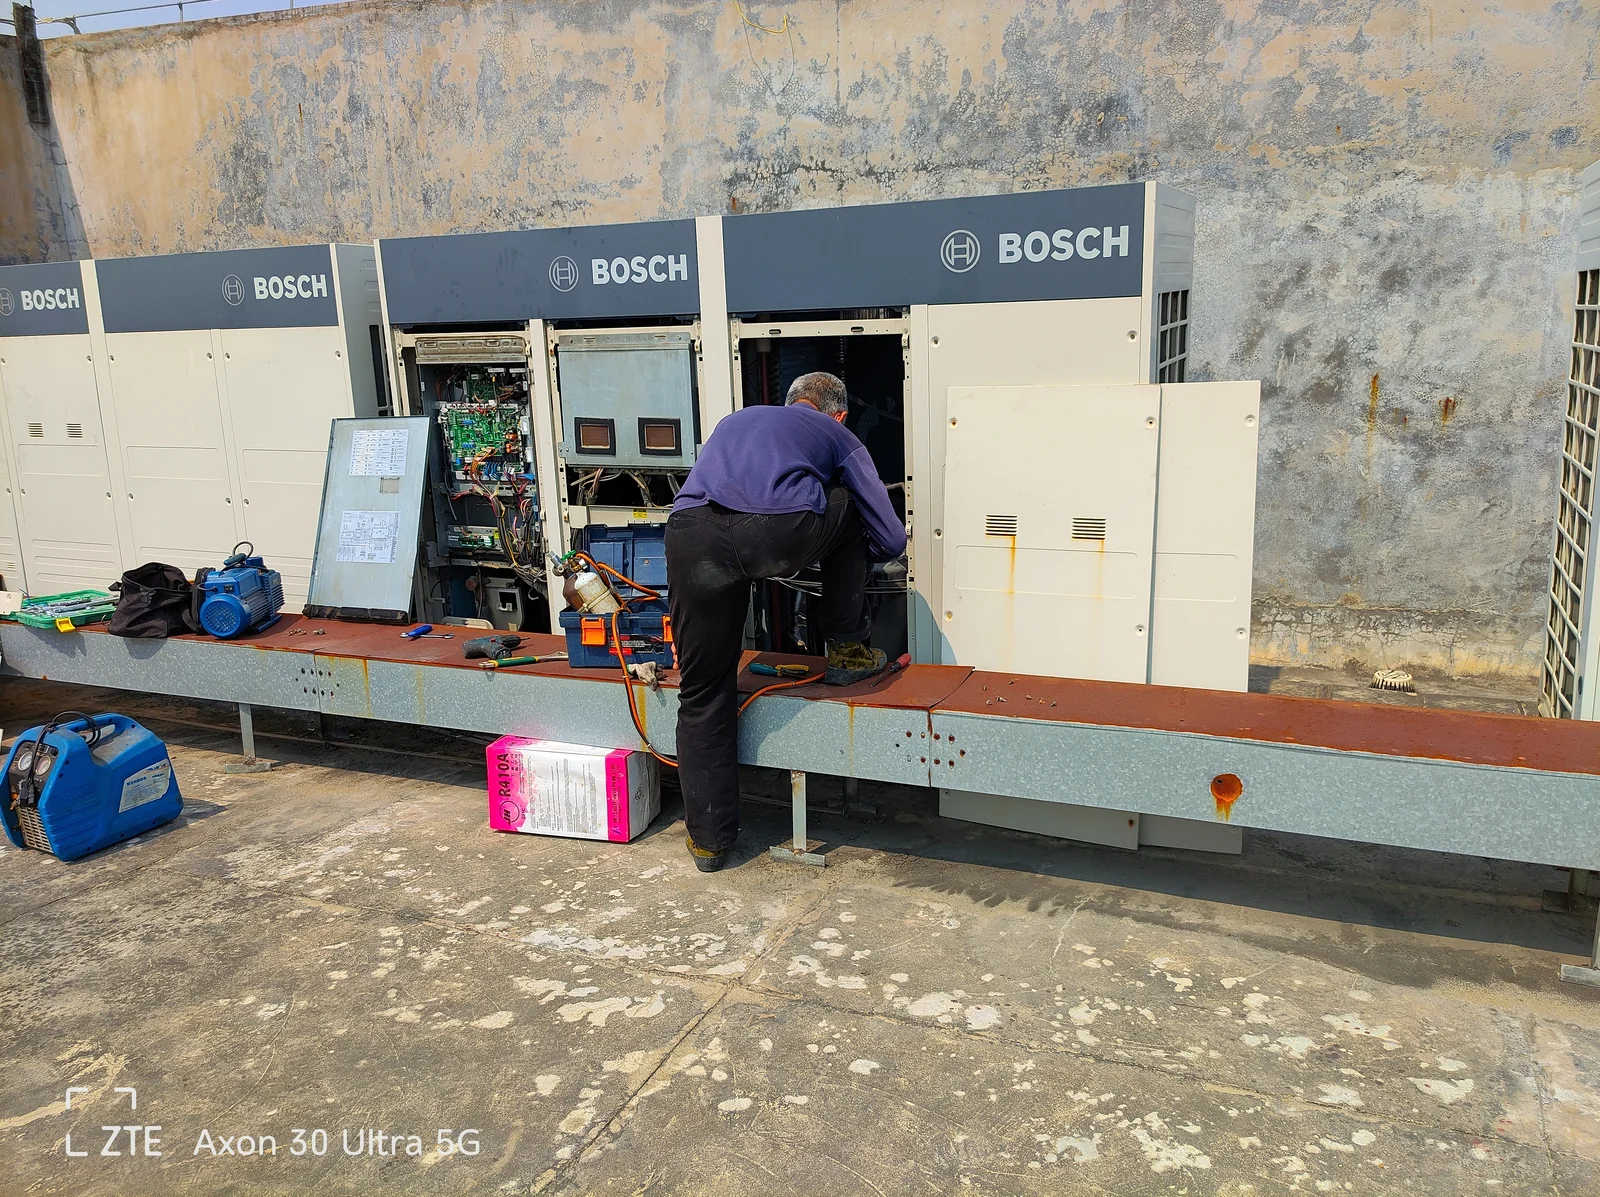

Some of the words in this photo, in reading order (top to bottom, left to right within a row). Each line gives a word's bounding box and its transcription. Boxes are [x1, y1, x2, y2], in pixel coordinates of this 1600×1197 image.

[999, 225, 1130, 264] BOSCH
[591, 253, 688, 285] BOSCH
[20, 287, 80, 311] BOSCH
[253, 274, 328, 300] BOSCH
[497, 753, 511, 797] R410A
